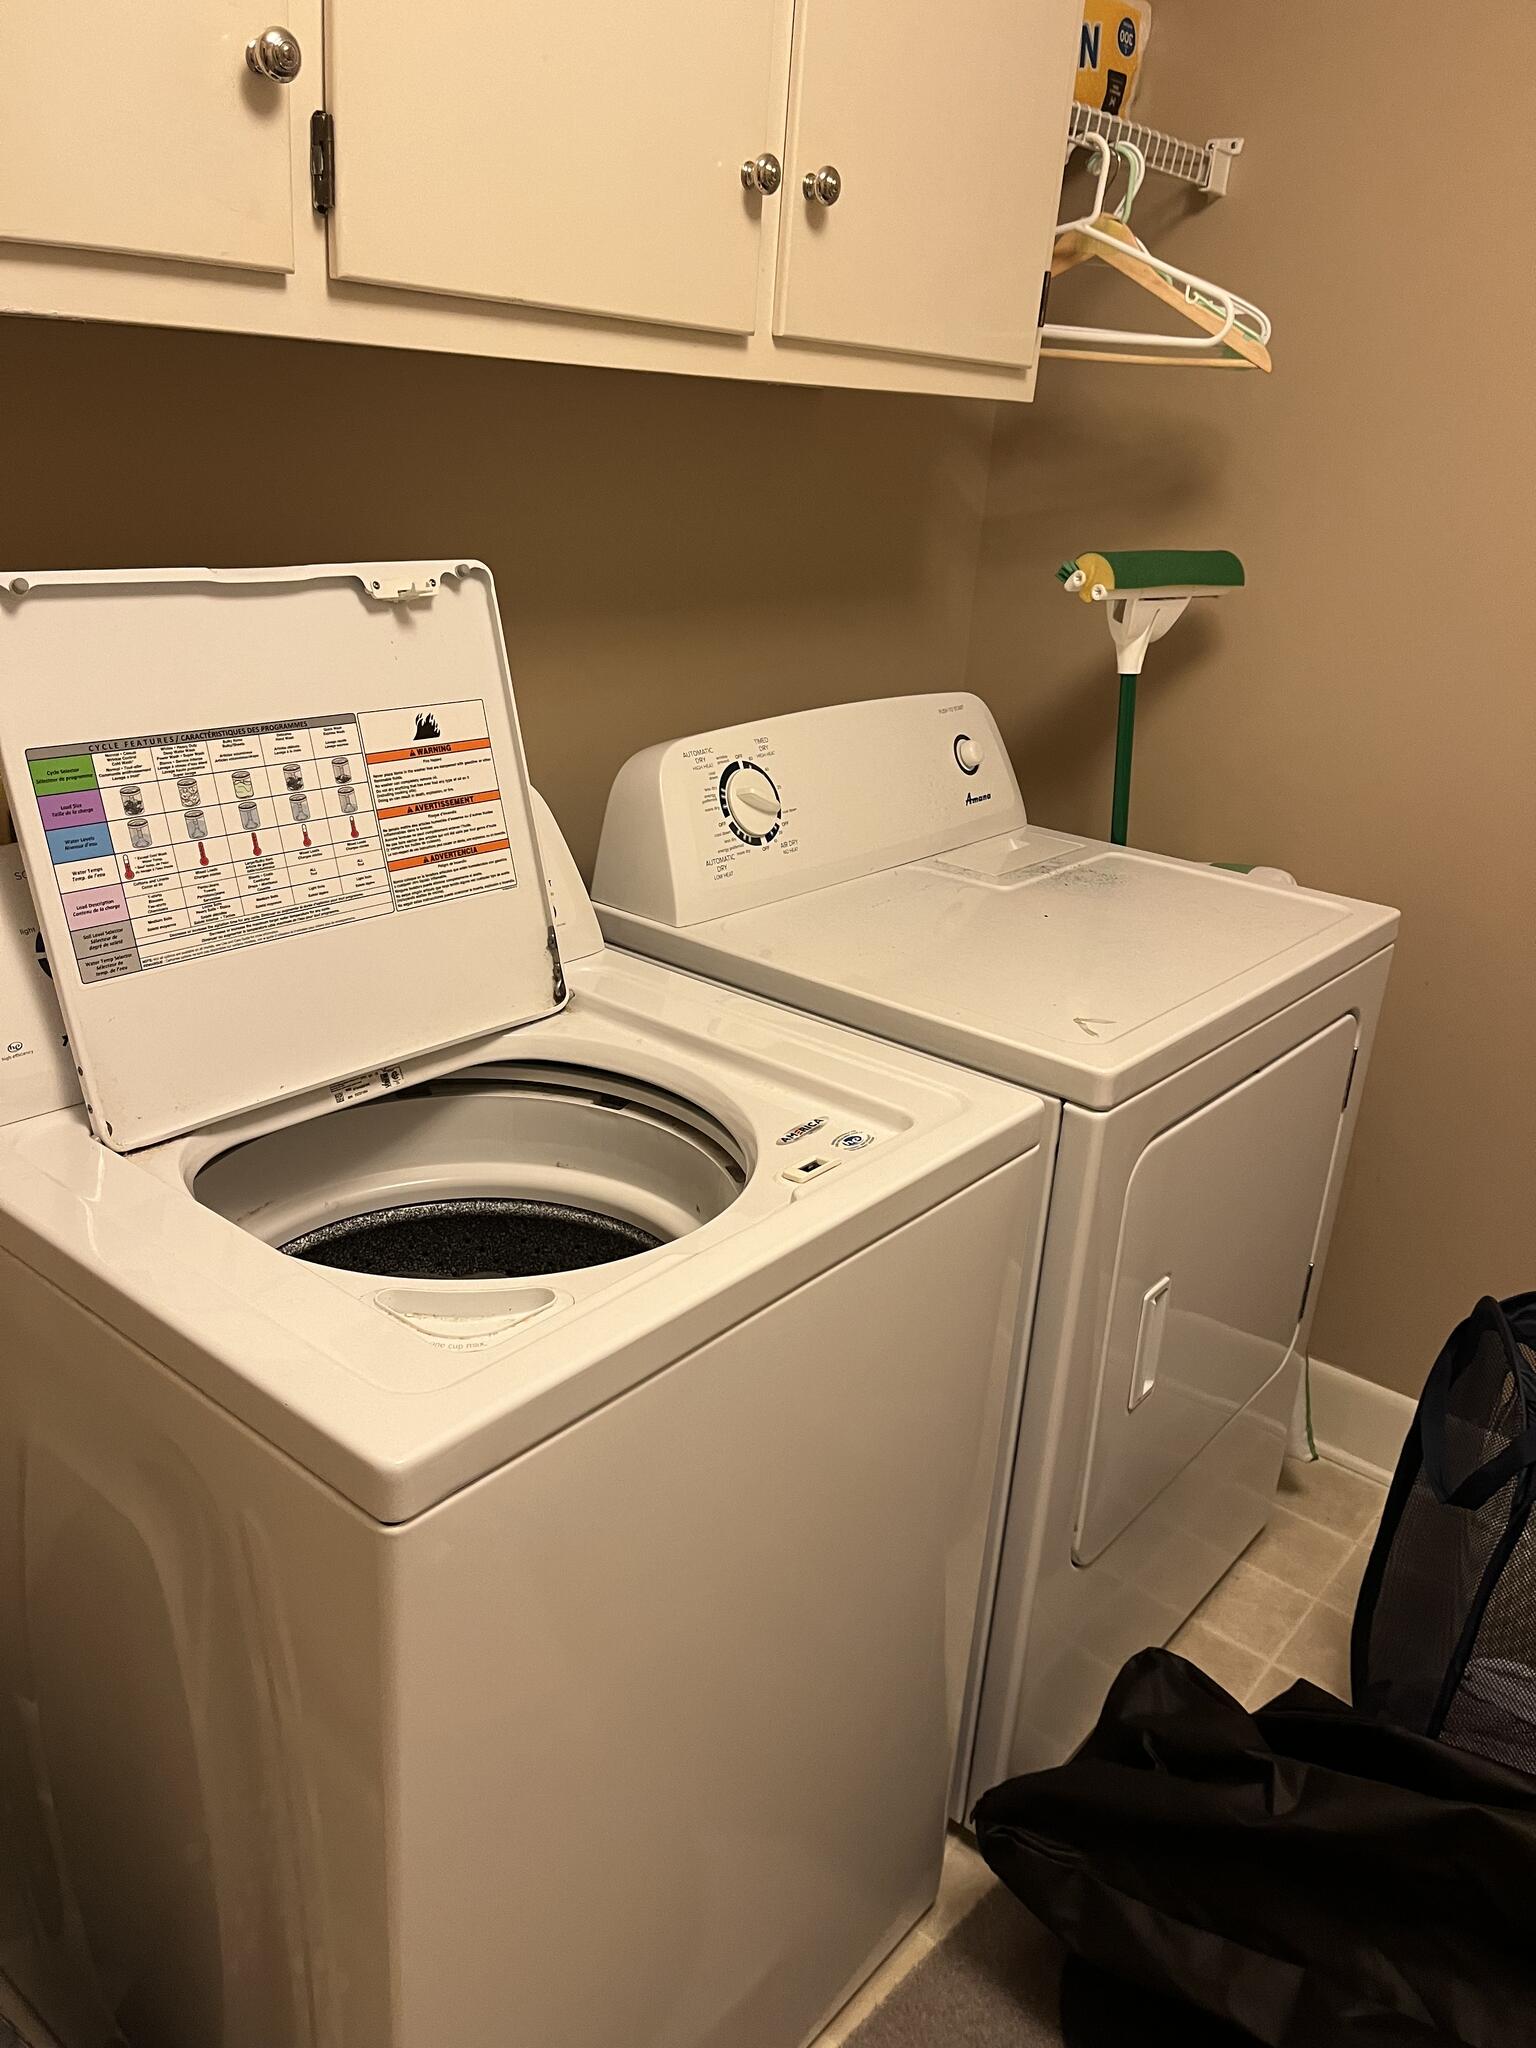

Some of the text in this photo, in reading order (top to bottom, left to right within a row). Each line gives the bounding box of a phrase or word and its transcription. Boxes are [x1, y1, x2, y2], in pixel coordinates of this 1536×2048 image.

[88, 742, 120, 752] CYCLE
[247, 726, 260, 734] DES
[261, 721, 308, 732] PROGRAMMES
[417, 744, 452, 756] WARNING
[683, 748, 714, 758] AUTOMATIC
[415, 796, 474, 811] AVERTISSEMENT
[430, 847, 478, 861] ADVERTENCIA
[706, 854, 735, 866] AUTOMATIC
[716, 864, 727, 872] DRY
[781, 1118, 824, 1143] AMERICA
